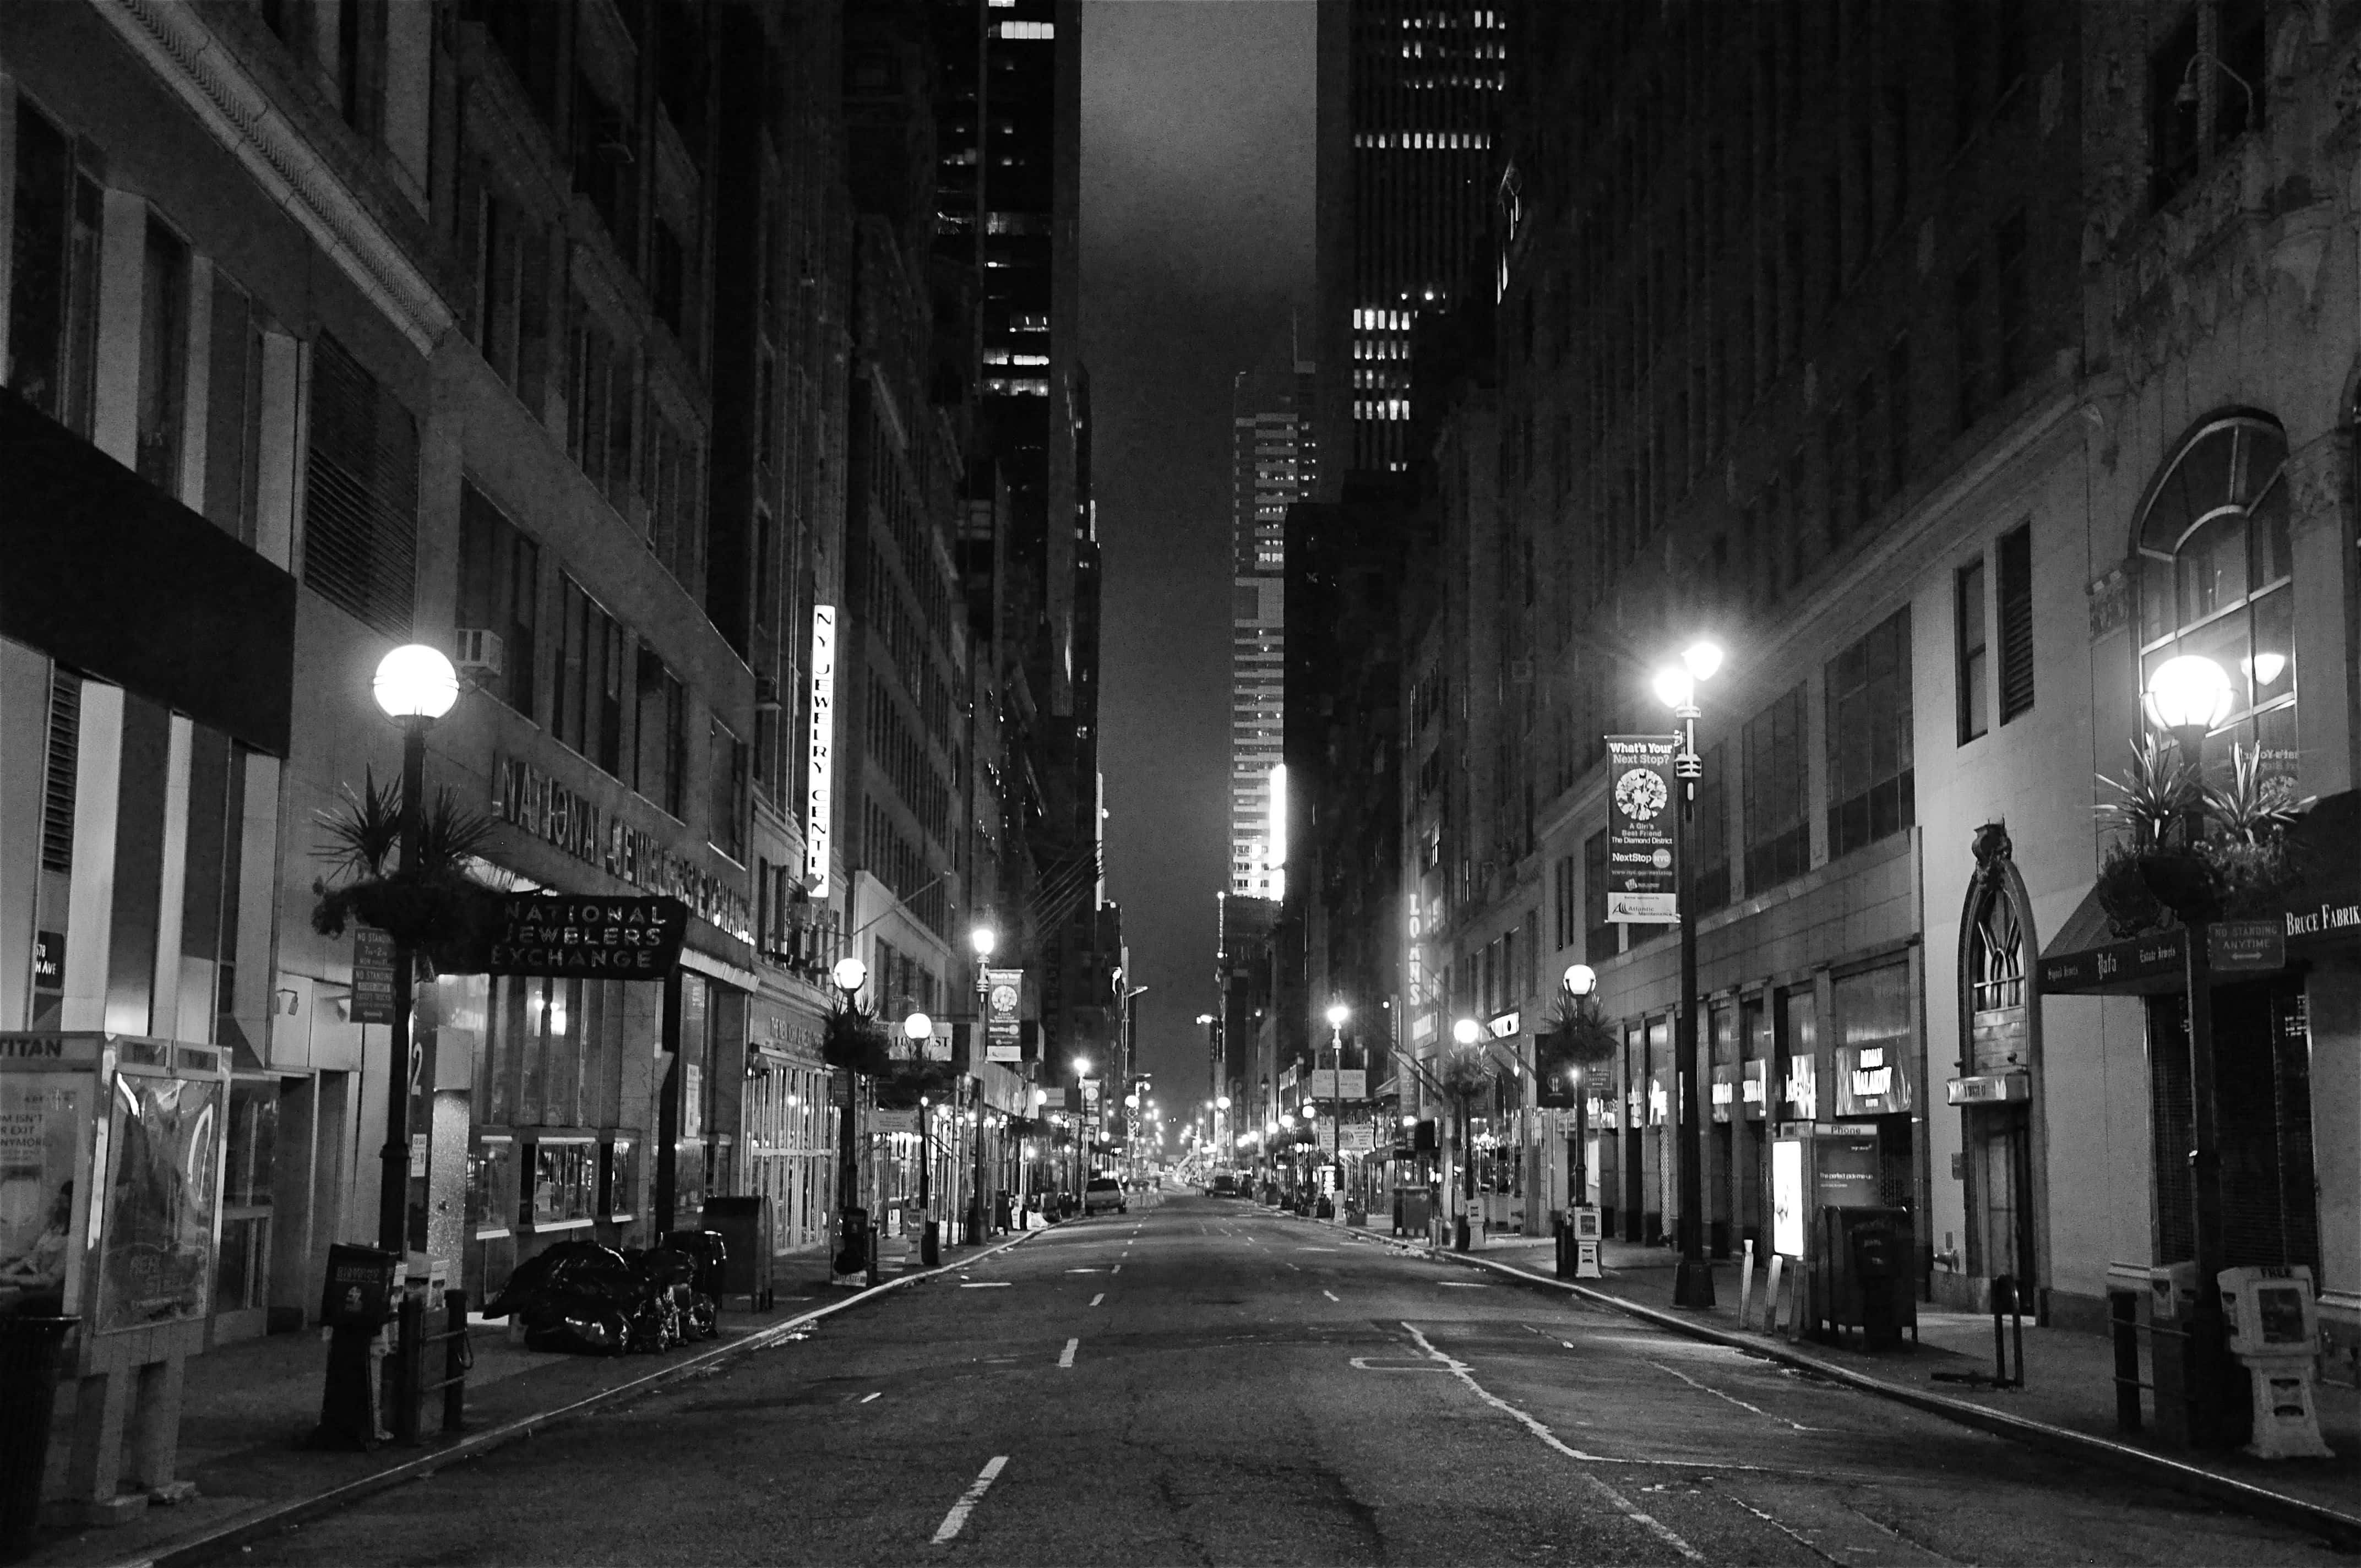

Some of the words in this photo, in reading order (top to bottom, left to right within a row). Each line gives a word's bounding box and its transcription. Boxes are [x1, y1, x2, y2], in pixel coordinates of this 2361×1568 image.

[813, 664, 830, 774] JEWELRY
[1610, 742, 1646, 753] What's
[1648, 742, 1672, 754] Your
[1613, 755, 1637, 764] Next
[1640, 754, 1669, 766] Stop?
[502, 761, 605, 867] NATIONAL
[1612, 853, 1652, 863] NextStop
[505, 901, 666, 924] NATIONAL
[2215, 929, 2227, 937] NO
[2233, 925, 2278, 936] STANDING
[2286, 912, 2319, 937] BRUCE
[502, 923, 660, 946] JEWELERS
[2223, 939, 2270, 950] ANYTIME
[491, 944, 652, 967] EXCHANGE
[11, 1126, 35, 1135] EXIT
